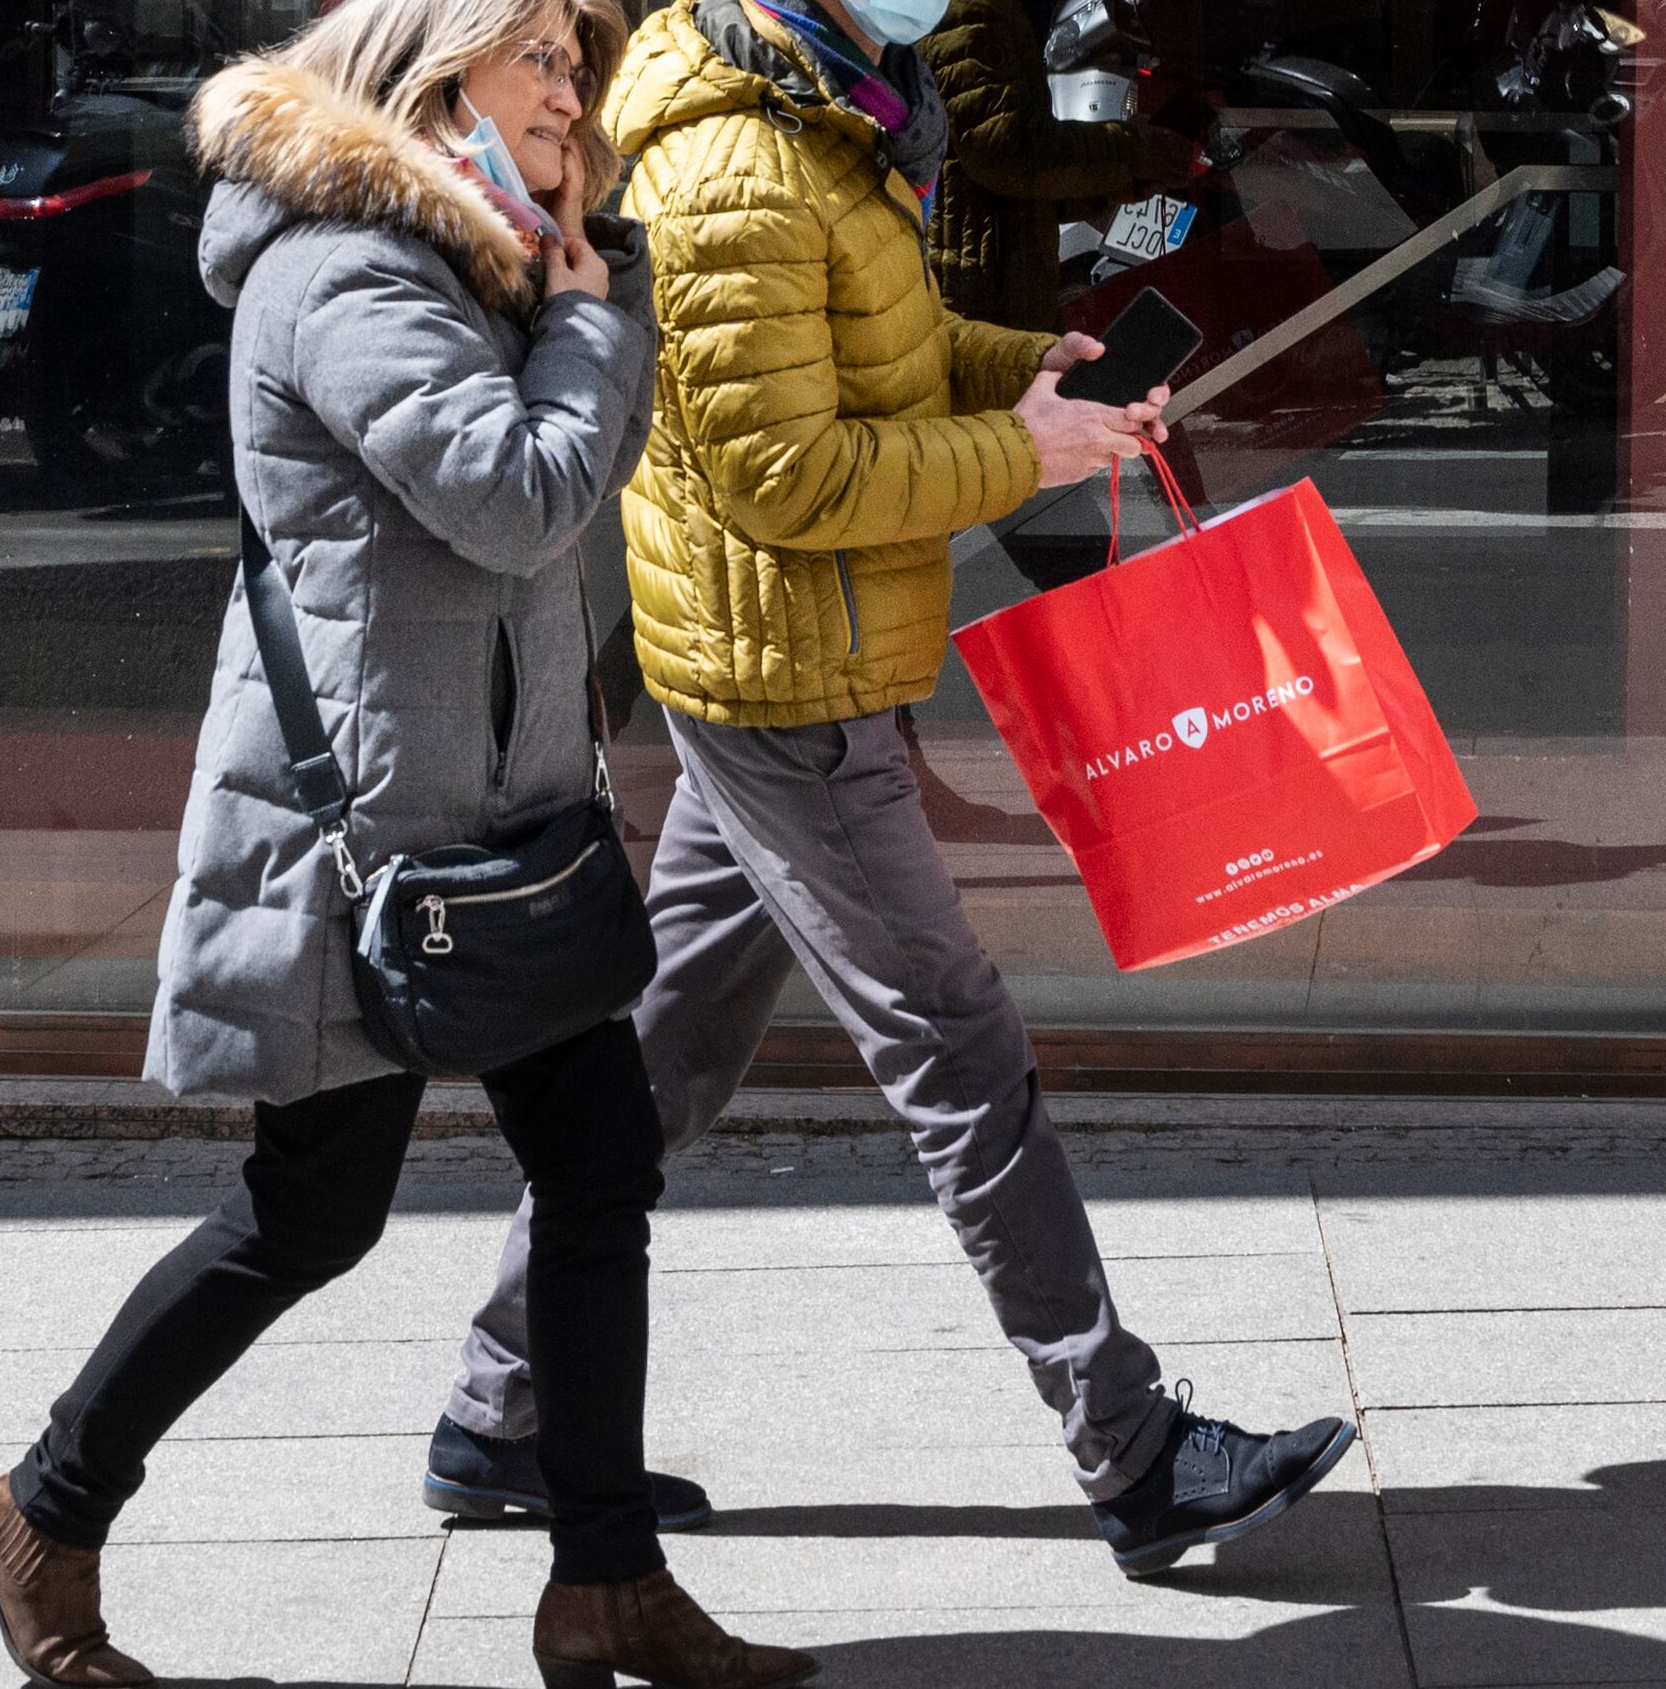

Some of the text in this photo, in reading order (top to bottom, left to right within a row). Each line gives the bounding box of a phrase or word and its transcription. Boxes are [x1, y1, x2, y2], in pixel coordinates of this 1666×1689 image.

[1085, 675, 1314, 781] ALVARO A MORENO
[1195, 849, 1324, 905] www.alvaromoreno.es
[1207, 882, 1365, 945] TENEMOS ALMA
